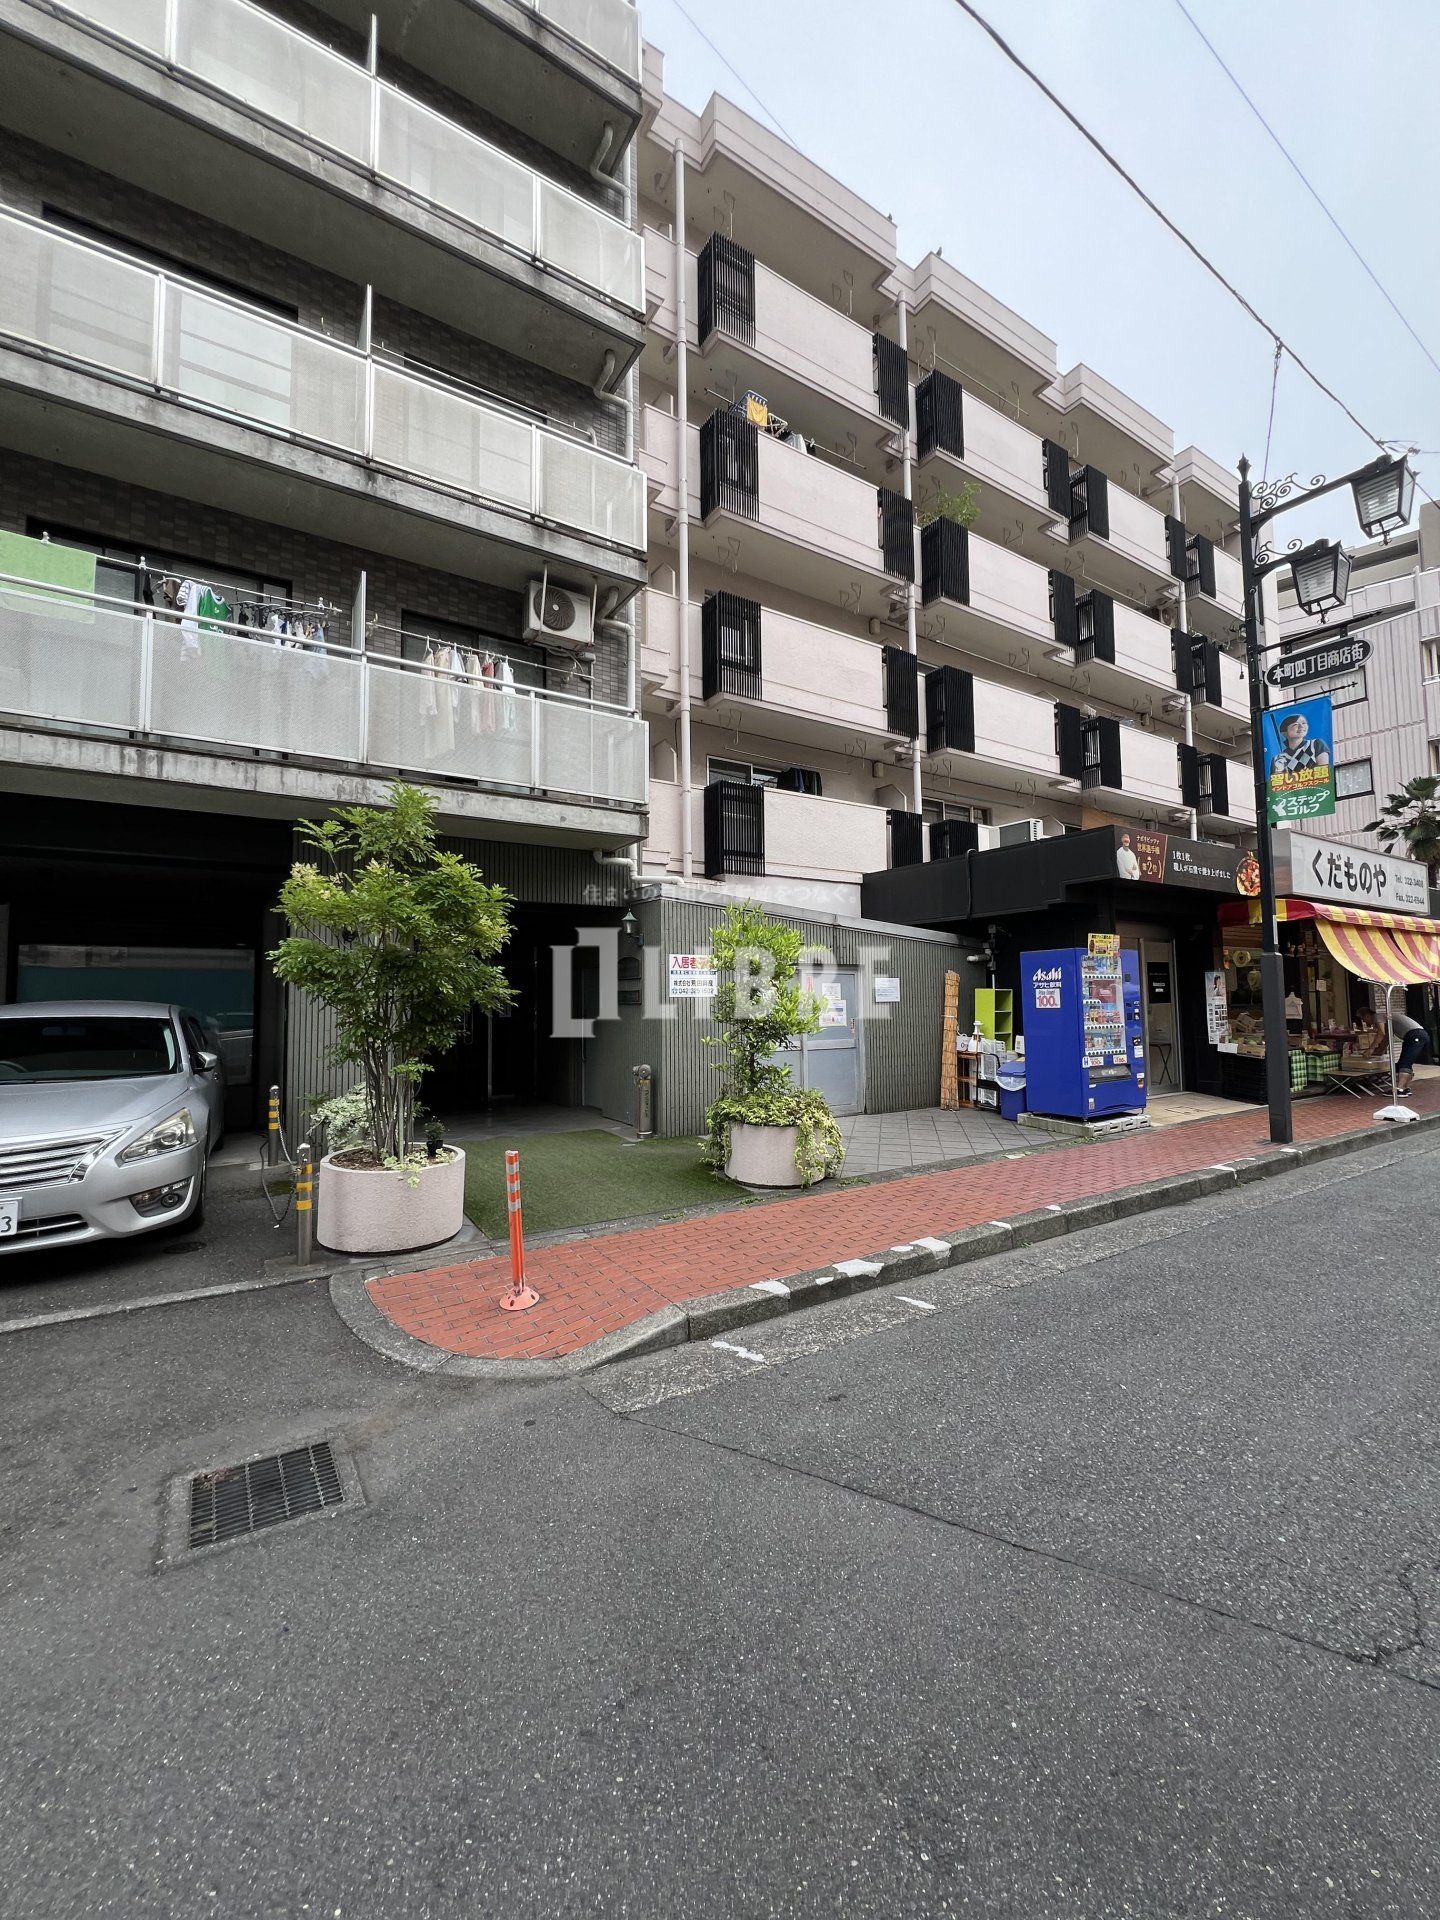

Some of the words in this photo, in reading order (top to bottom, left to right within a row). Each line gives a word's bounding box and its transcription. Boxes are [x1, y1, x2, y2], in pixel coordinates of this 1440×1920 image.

[1272, 642, 1364, 682] 本町四丁目商店街
[1270, 766, 1330, 786] 習い放題
[1287, 789, 1331, 806] ステップ
[1287, 803, 1320, 815] ゴルフ
[1311, 849, 1387, 898] くだものや
[1032, 966, 1062, 982] Asahi
[1033, 981, 1062, 989] アサヒ飲料
